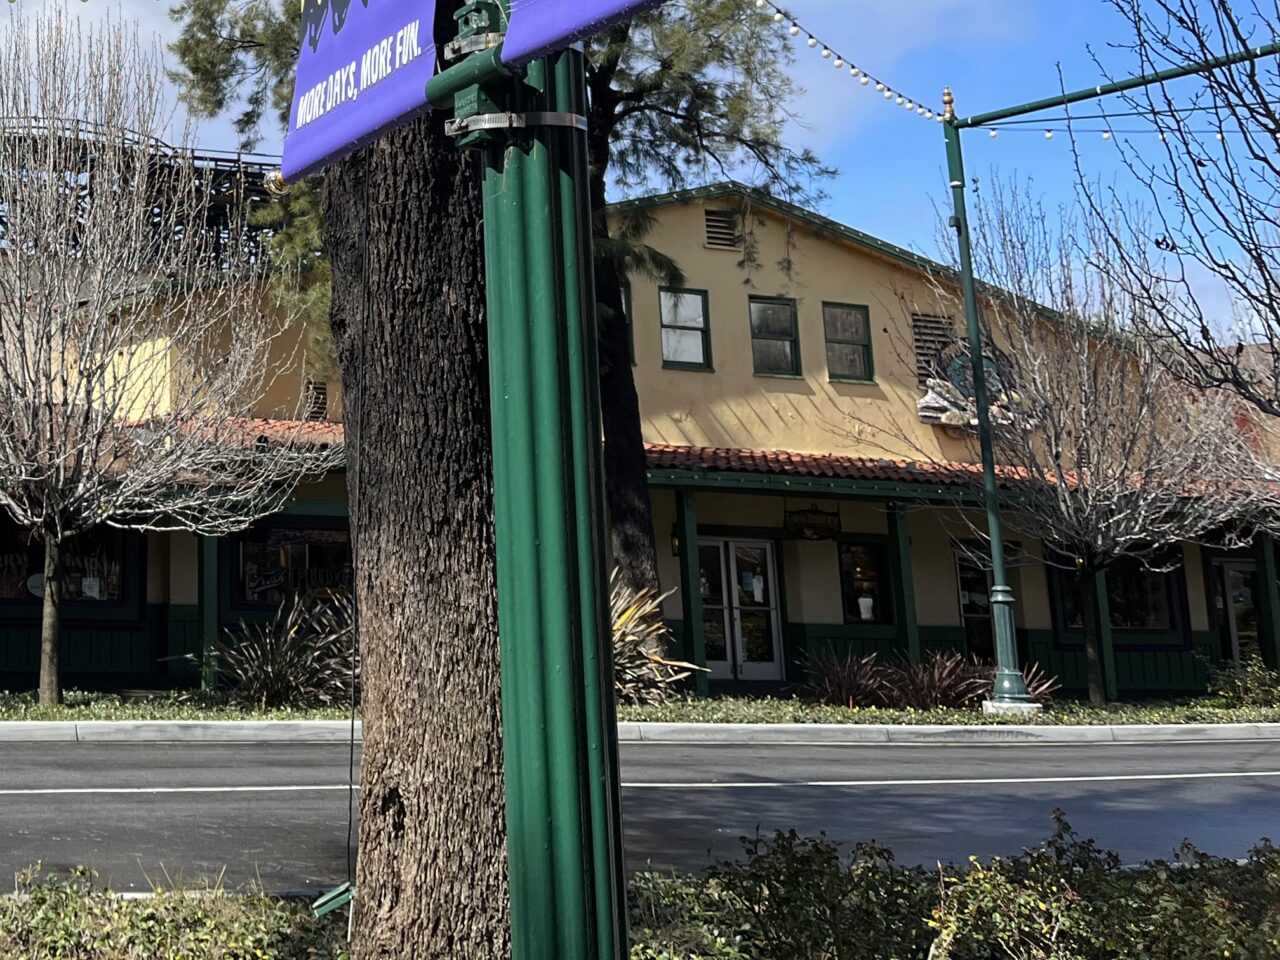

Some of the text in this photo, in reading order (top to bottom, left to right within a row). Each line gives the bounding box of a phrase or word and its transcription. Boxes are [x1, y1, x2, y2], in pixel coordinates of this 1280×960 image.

[296, 20, 422, 129] MORE DAYS, MORE FUN.
